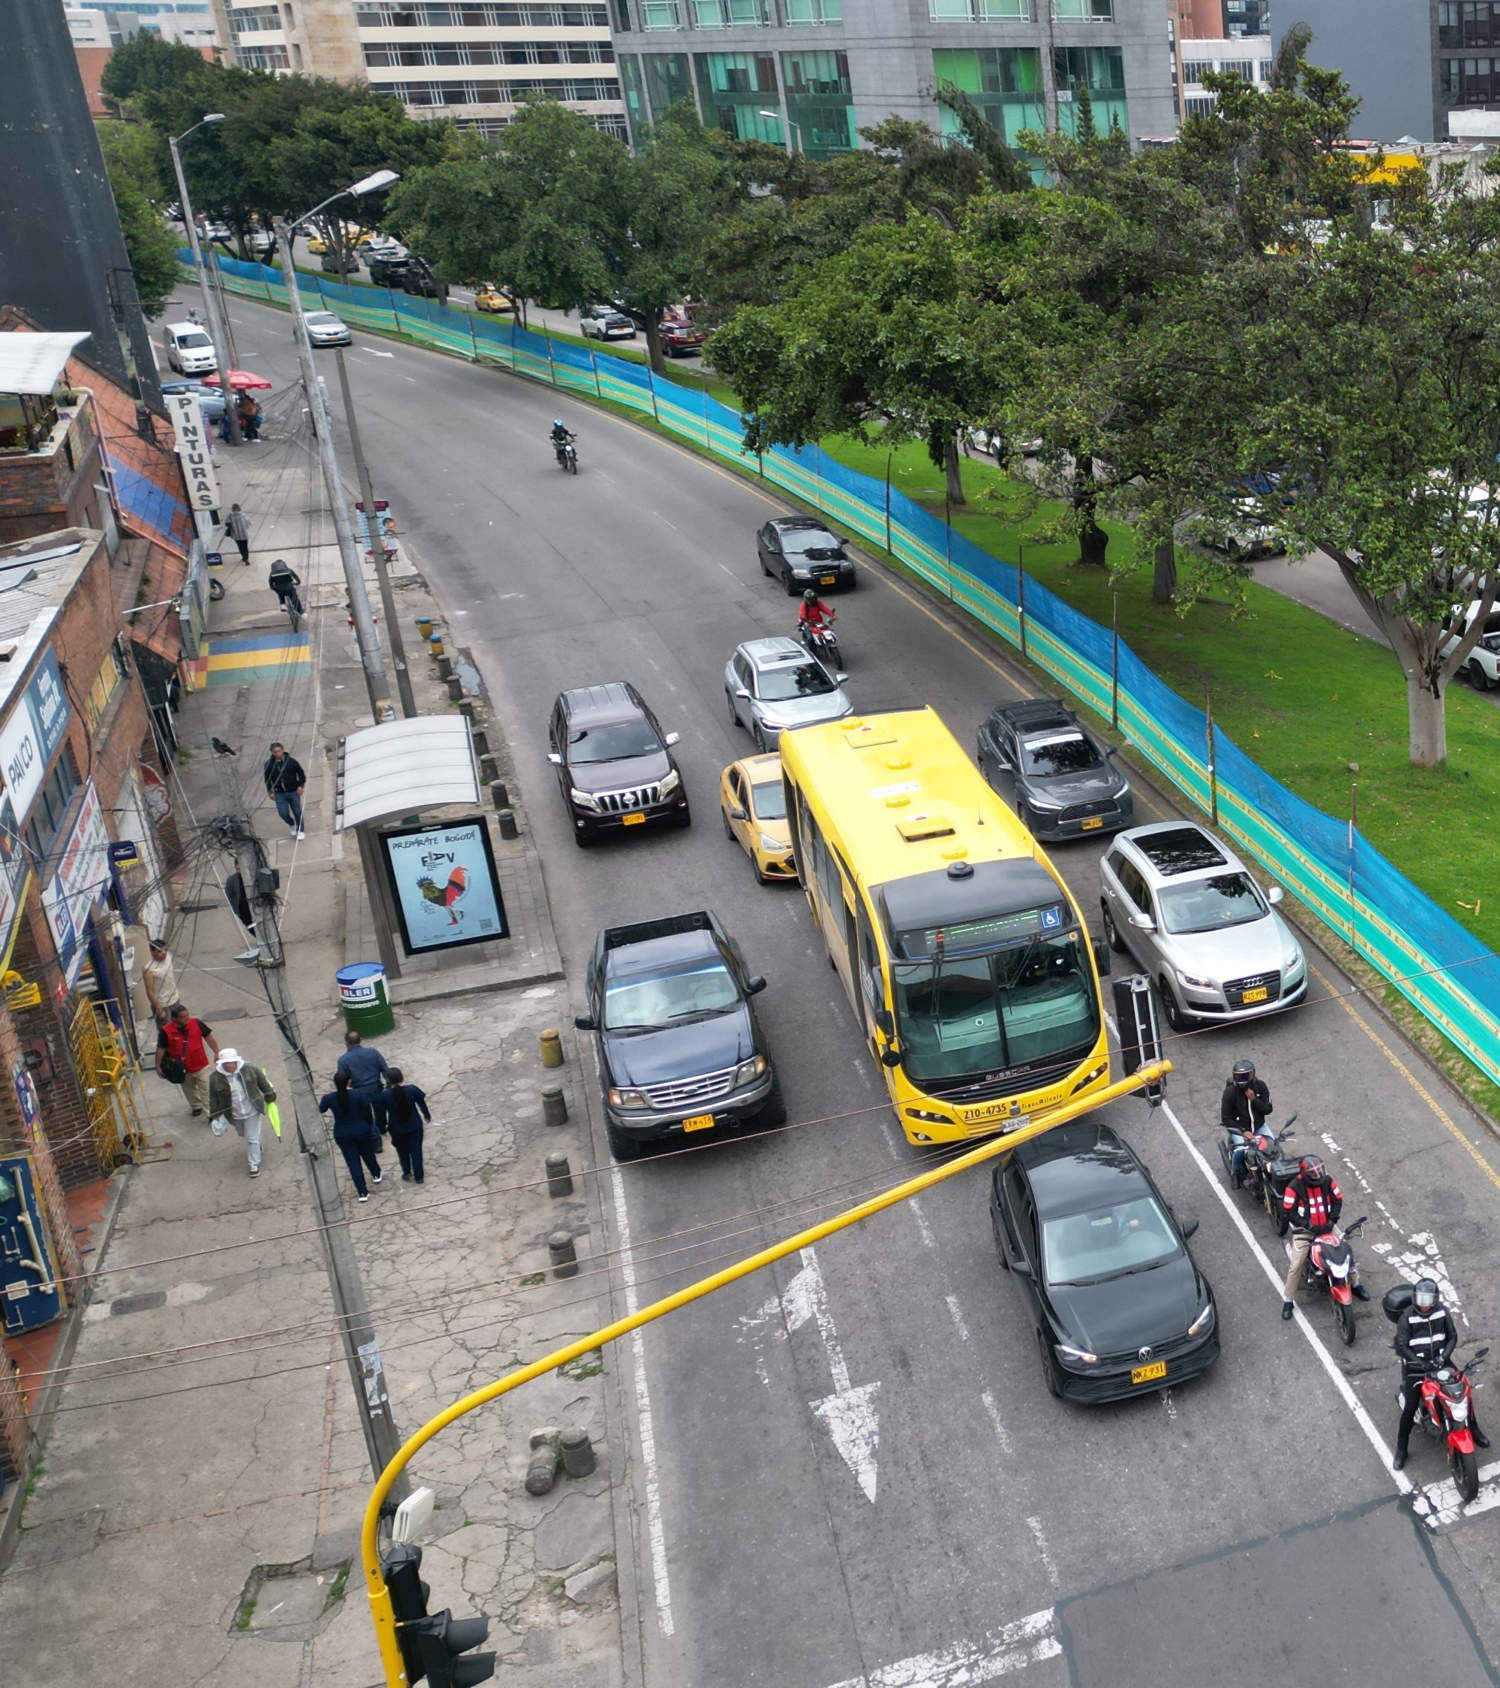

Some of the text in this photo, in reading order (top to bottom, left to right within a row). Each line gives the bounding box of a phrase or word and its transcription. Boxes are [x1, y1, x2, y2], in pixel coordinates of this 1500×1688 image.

[177, 397, 214, 507] PINTURAS
[1021, 1093, 1064, 1110] TransMilenio
[963, 1103, 1008, 1120] Z10-4735
[1149, 1366, 1164, 1377] 931
